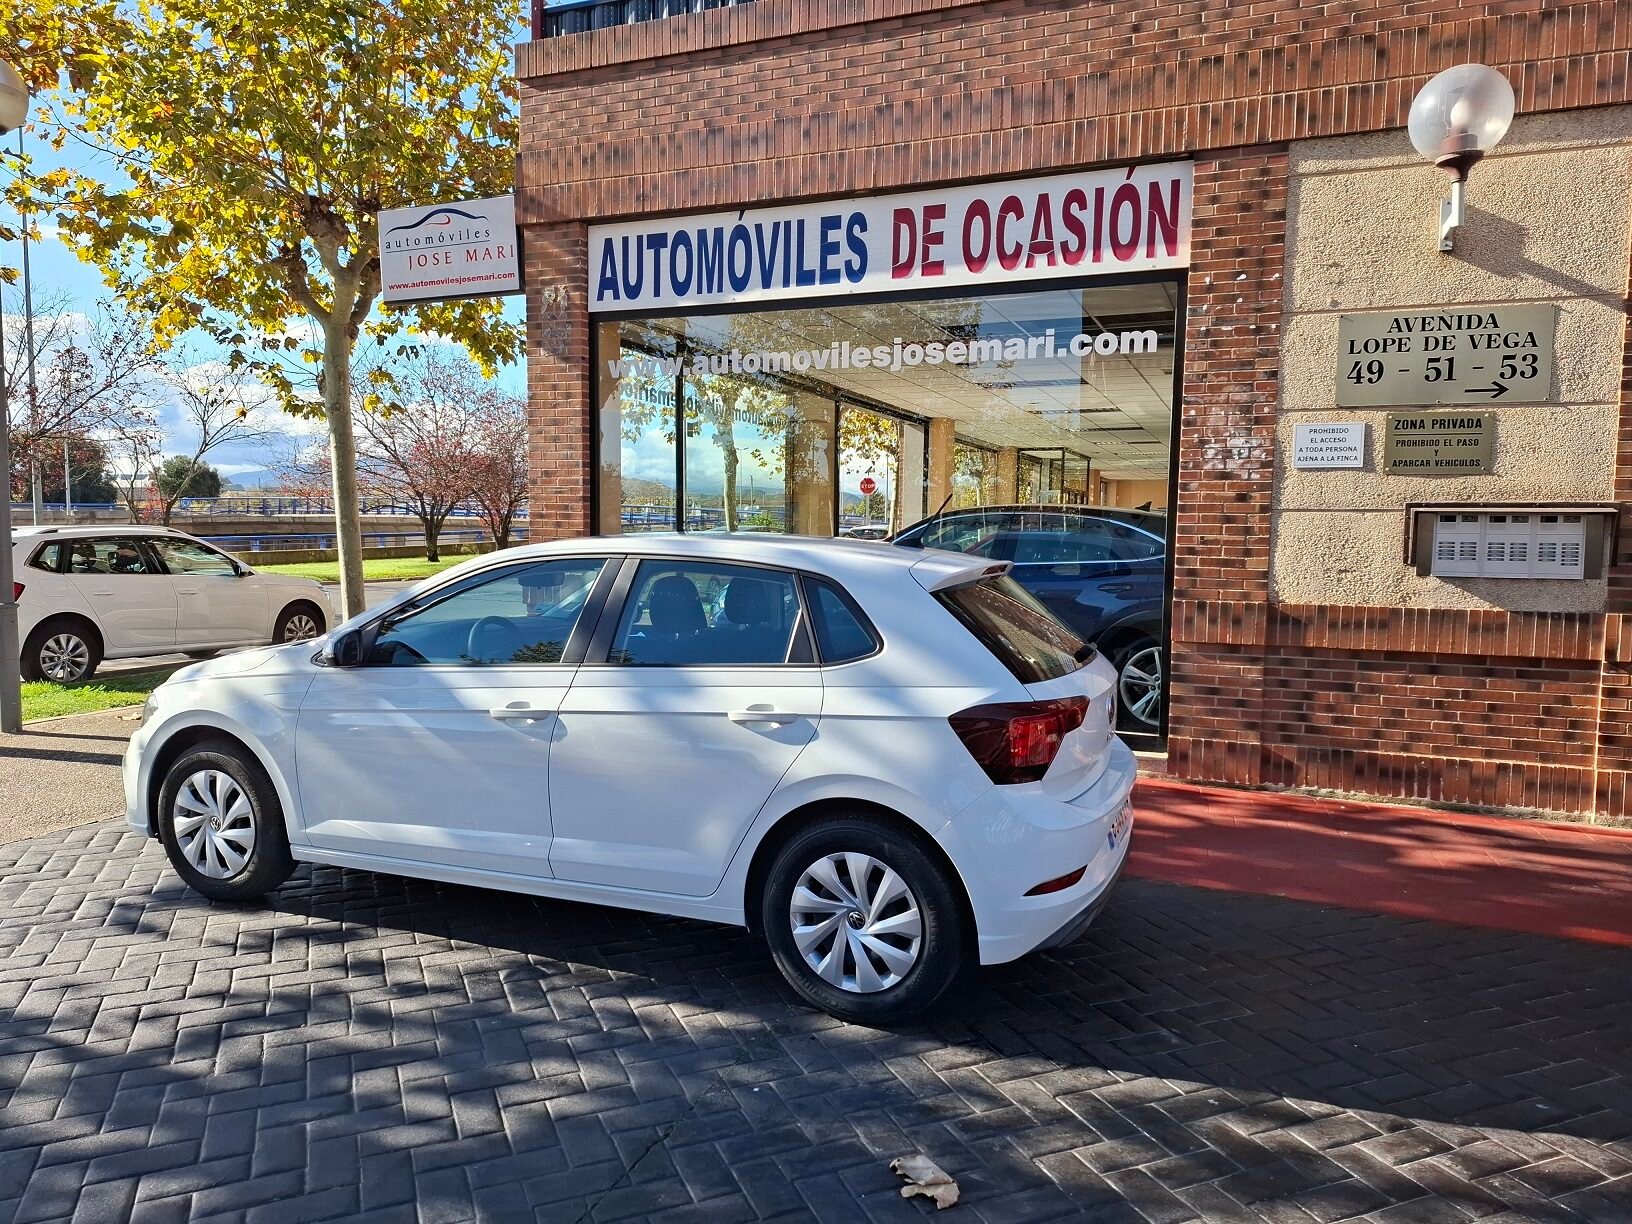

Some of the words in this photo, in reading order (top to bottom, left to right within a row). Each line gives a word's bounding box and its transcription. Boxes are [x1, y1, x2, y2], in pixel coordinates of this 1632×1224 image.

[385, 228, 490, 250] automóviles
[596, 209, 869, 302] AUTOMÓVILES
[891, 203, 947, 280] DE
[961, 166, 1181, 275] OCASIÓN
[408, 251, 453, 271] JOSE
[466, 244, 515, 263] MARI
[388, 271, 516, 291] www.automovilesjosemari.com
[1386, 312, 1501, 334] AVENIDA
[608, 328, 1158, 379] www.automovilesjosemari.com
[1348, 336, 1412, 355] LOPE
[1422, 334, 1457, 352] DE
[1467, 331, 1540, 350] VEGA
[1346, 359, 1385, 385] 49
[1423, 356, 1458, 383] 51
[1498, 353, 1540, 380] 53
[1308, 427, 1350, 435] PROHIBIDO
[1394, 418, 1426, 430] ZONA
[1431, 417, 1483, 429] PRIVADA
[1395, 438, 1440, 447] PROHIBIDO
[1443, 438, 1454, 447] EL
[1456, 438, 1480, 446] PASO
[1433, 448, 1440, 457] Y
[1391, 459, 1431, 467] APARCAR
[1434, 458, 1481, 467] VEHICULOS
